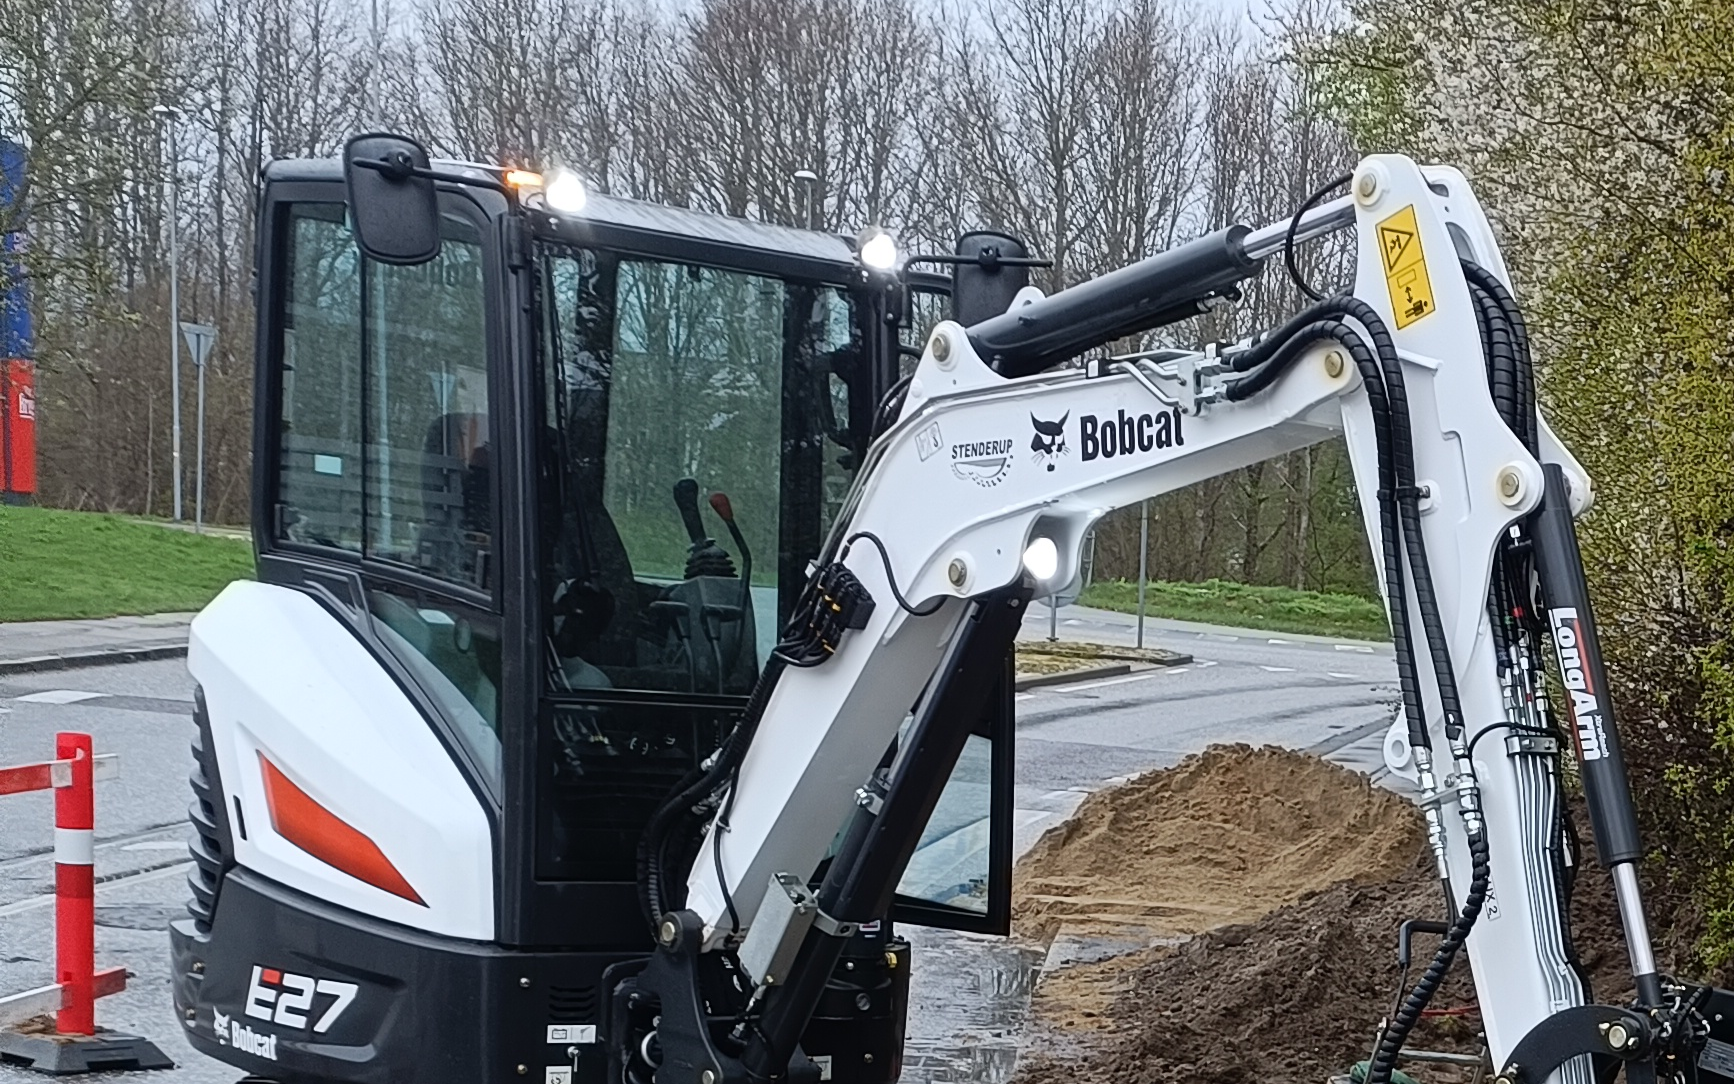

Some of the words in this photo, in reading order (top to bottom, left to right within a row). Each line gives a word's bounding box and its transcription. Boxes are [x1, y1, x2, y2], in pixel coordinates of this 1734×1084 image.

[951, 438, 1013, 459] STENDERUP
[1080, 408, 1184, 461] Bobcat
[245, 965, 359, 1033] E27
[231, 1020, 278, 1061] Bobcat
